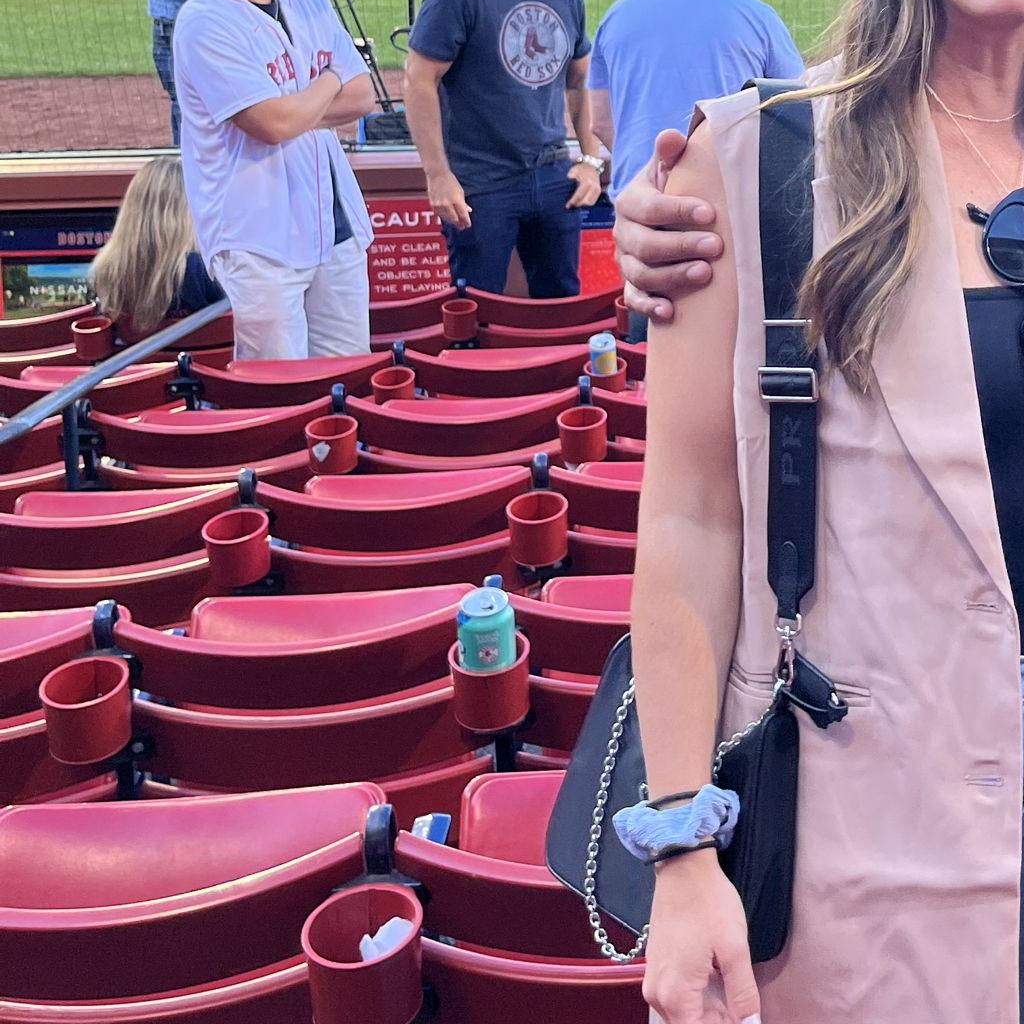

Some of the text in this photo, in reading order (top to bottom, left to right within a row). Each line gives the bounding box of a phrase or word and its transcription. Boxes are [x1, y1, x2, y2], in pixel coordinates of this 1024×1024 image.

[509, 7, 559, 33] BOSTON
[510, 54, 560, 78] RED SOX
[370, 243, 441, 254] STAY CLEAR
[373, 257, 396, 267] AND
[401, 257, 417, 266] BE
[377, 270, 431, 281] OBJECTS
[29, 284, 88, 296] NISSAN
[374, 284, 397, 294] THE
